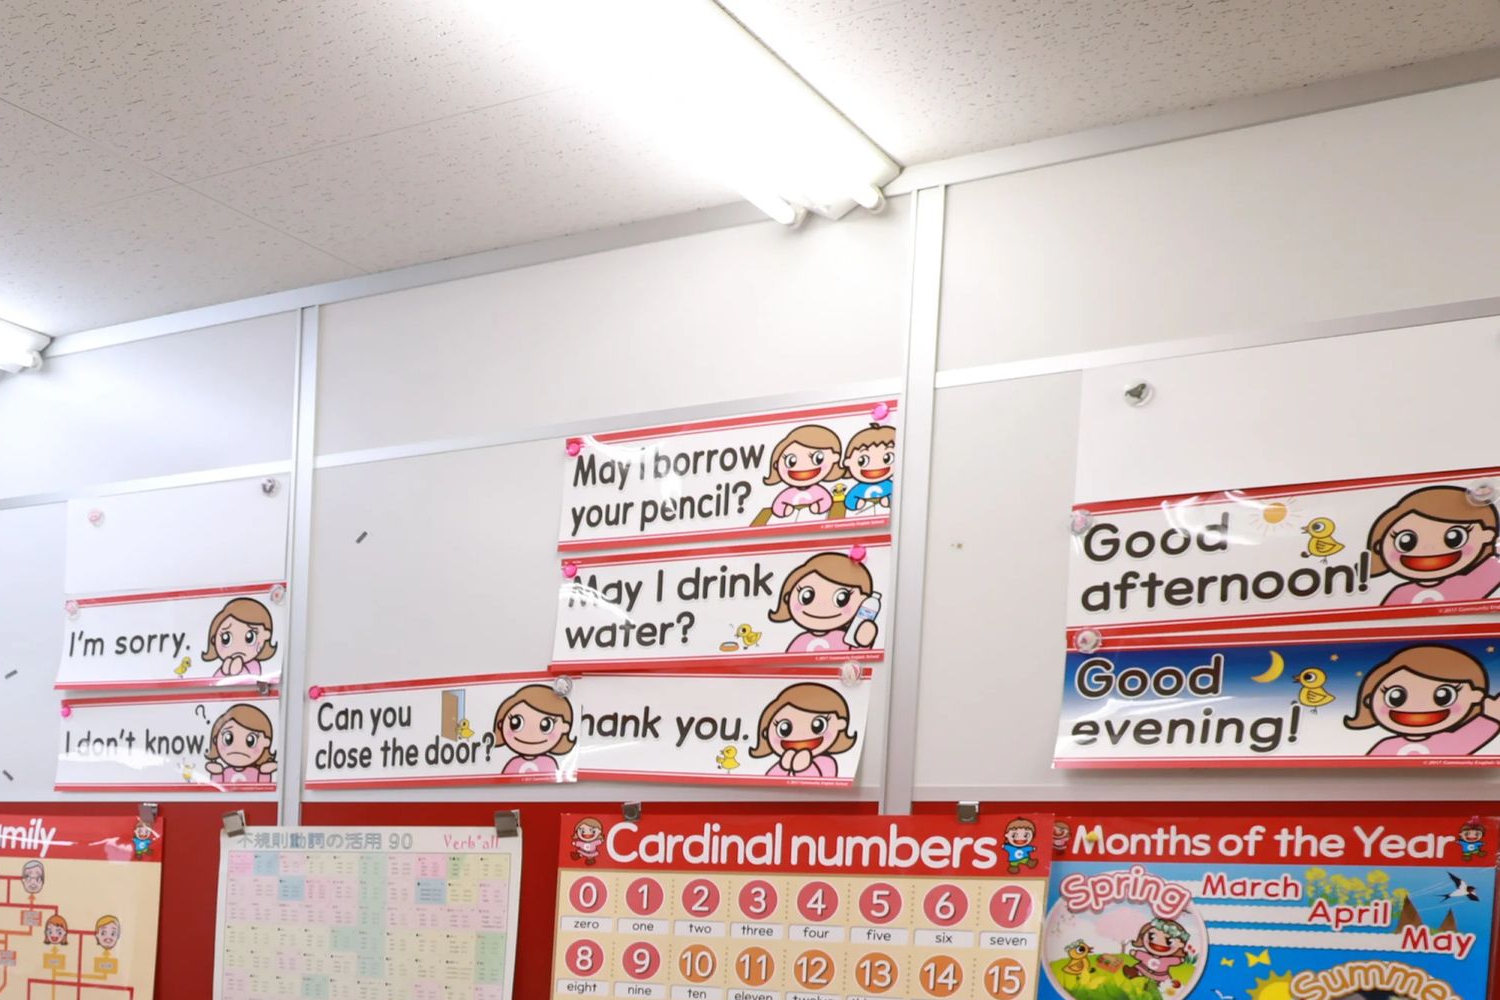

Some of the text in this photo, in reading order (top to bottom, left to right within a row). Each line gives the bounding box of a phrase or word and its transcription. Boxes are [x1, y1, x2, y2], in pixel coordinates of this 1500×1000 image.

[573, 454, 630, 490] May
[654, 443, 765, 478] borrow
[571, 481, 752, 537] your pencil?
[1082, 512, 1229, 562] Good
[567, 563, 775, 612] May I drink
[1081, 551, 1369, 611] afternoon!
[565, 611, 695, 648] water?
[69, 630, 191, 658] I'm sorry.
[1077, 655, 1224, 698] Good
[317, 702, 411, 736] Can you
[581, 705, 749, 747] hank you.
[1071, 705, 1301, 753] evening!
[66, 728, 209, 757] I don't know.
[315, 733, 495, 770] close the door?
[389, 833, 413, 849] 90
[606, 821, 998, 870] Cardinal numbers
[1071, 824, 1456, 859] Months of the Year
[579, 882, 598, 908] 0
[637, 884, 649, 910] 1
[691, 885, 710, 912] 2
[749, 887, 767, 914] 3
[1059, 864, 1193, 921] Spring
[1202, 874, 1301, 899] March
[806, 888, 827, 916] 4
[870, 890, 890, 918] 5
[935, 892, 955, 920] 6
[1001, 892, 1022, 921] 7
[1308, 900, 1392, 930] April
[573, 919, 599, 930] zero
[632, 922, 654, 931] one
[689, 923, 712, 934] two
[741, 925, 774, 937] three
[803, 927, 830, 939] four
[866, 929, 892, 942] five
[935, 933, 953, 944] six
[989, 936, 1028, 946] seven
[1401, 926, 1475, 959] May
[576, 945, 593, 971] 8
[632, 948, 650, 974] 9
[682, 950, 713, 978] 10
[740, 953, 766, 981] 11
[796, 956, 828, 984] 12
[566, 981, 597, 993] eight
[860, 959, 892, 988] 13
[923, 962, 958, 990] 14
[988, 965, 1022, 995] 15
[628, 984, 652, 996] nine
[688, 988, 707, 999] ten
